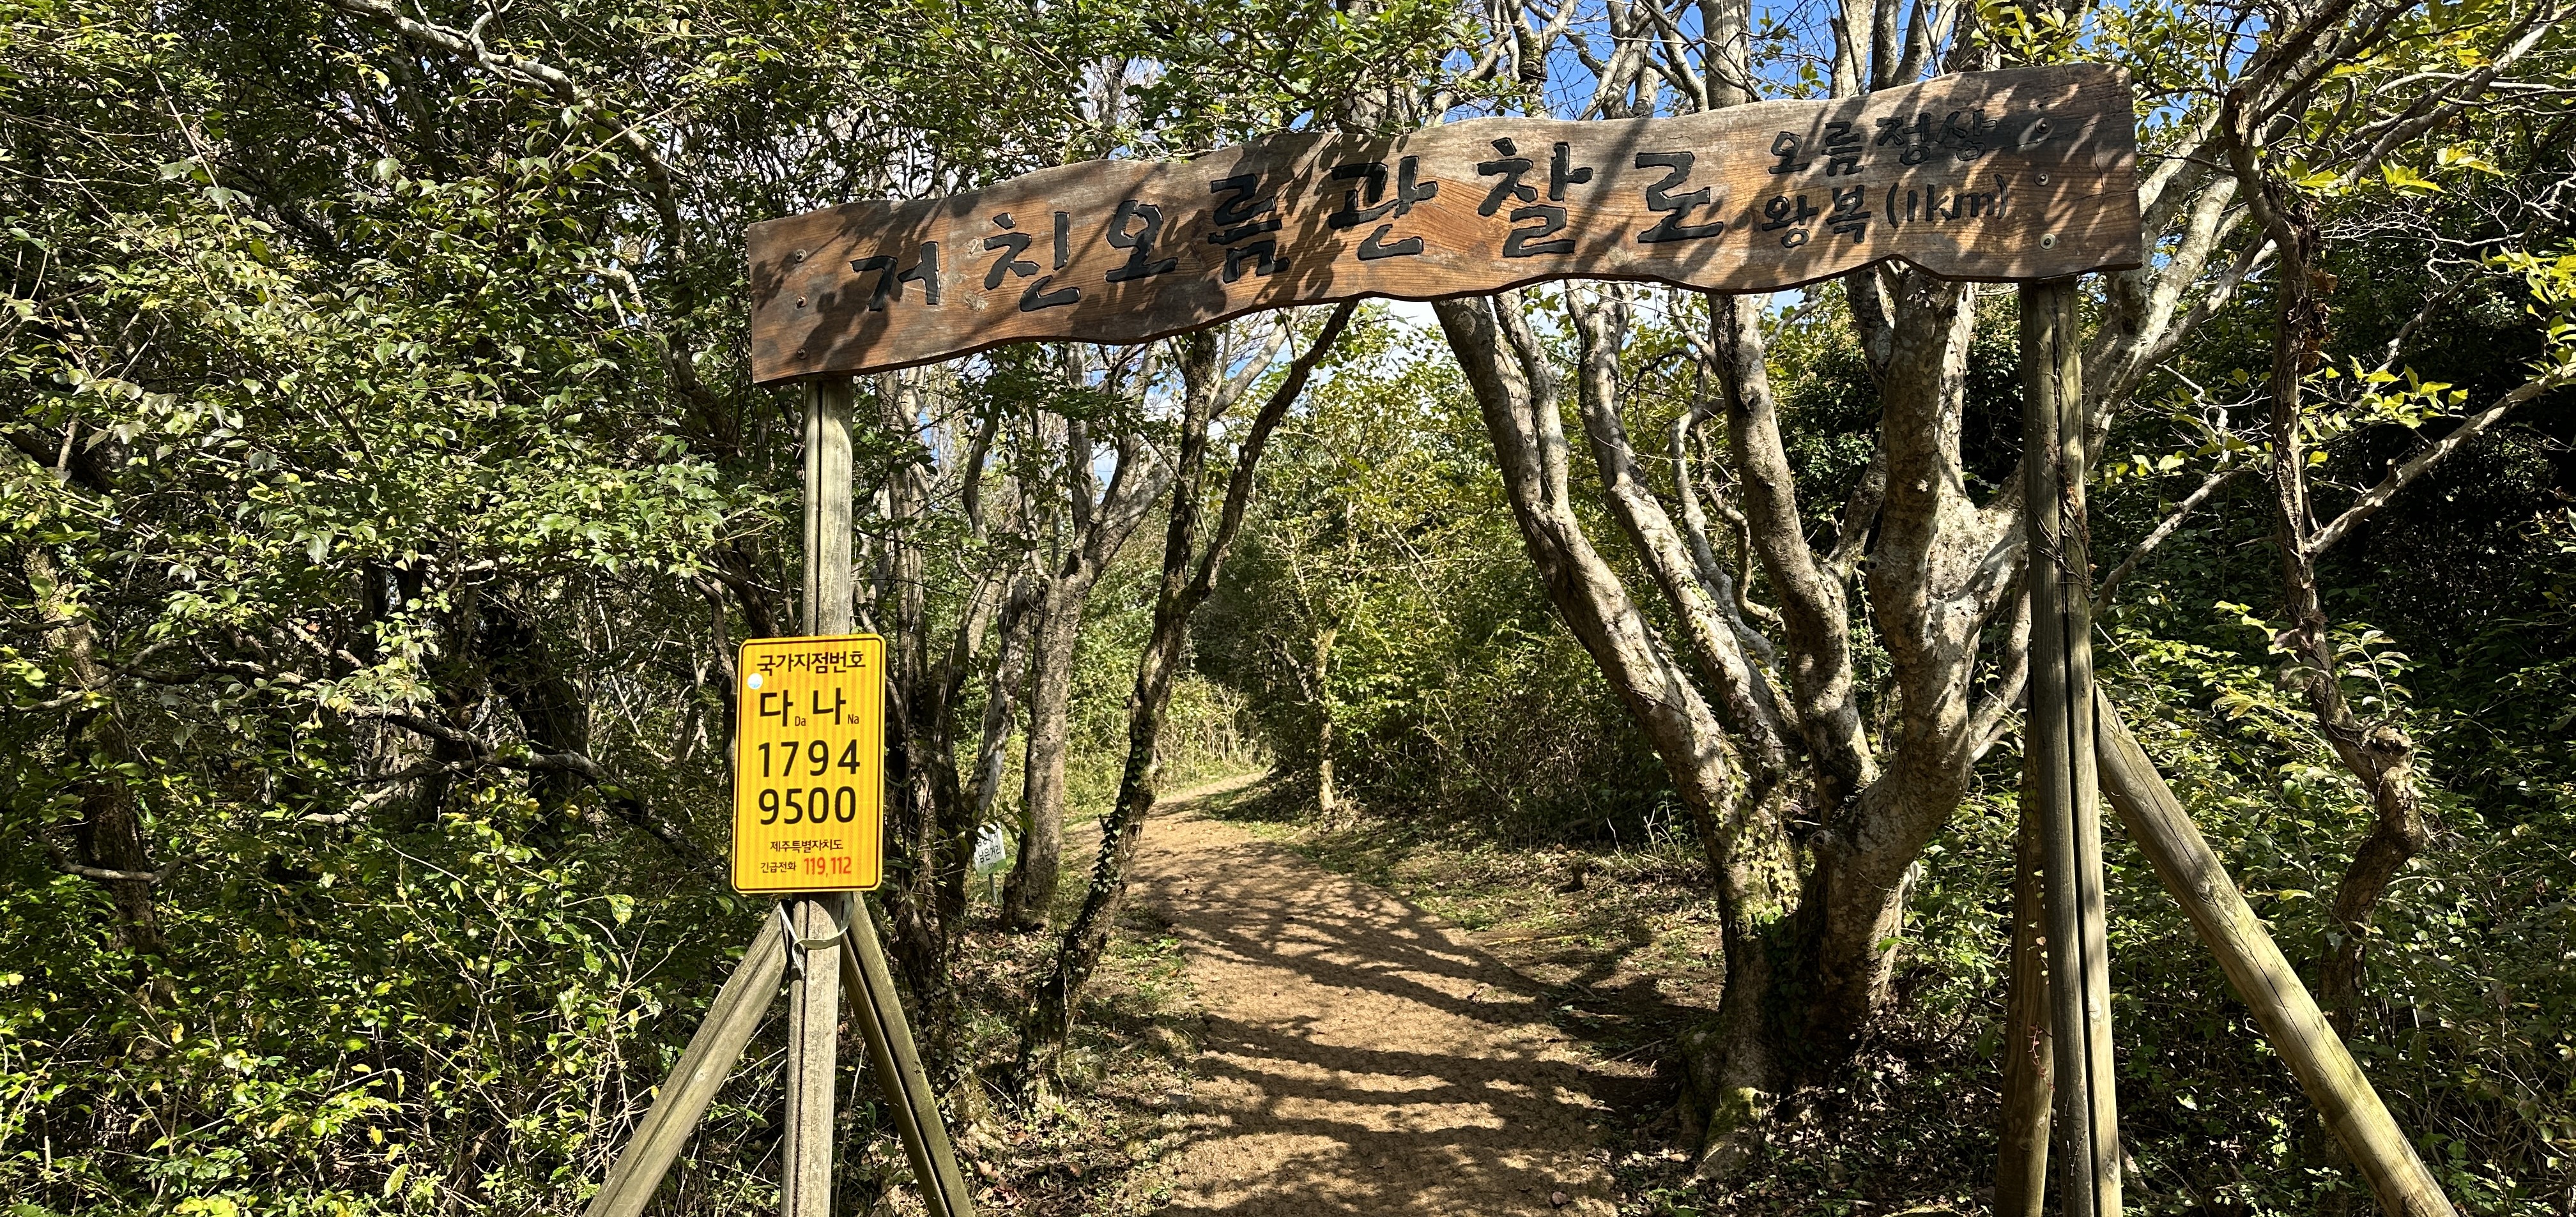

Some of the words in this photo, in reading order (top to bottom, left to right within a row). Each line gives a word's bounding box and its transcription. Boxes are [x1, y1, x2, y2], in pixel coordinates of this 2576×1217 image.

[756, 650, 866, 676] 국가지점번호
[759, 689, 793, 727] 다
[795, 716, 806, 726] Da
[812, 687, 847, 725] 나
[847, 713, 859, 724] Na
[758, 739, 861, 777] 1794
[758, 786, 856, 825] 9500
[770, 839, 844, 853] 제주특별자치도
[760, 861, 797, 873] 긴급전화
